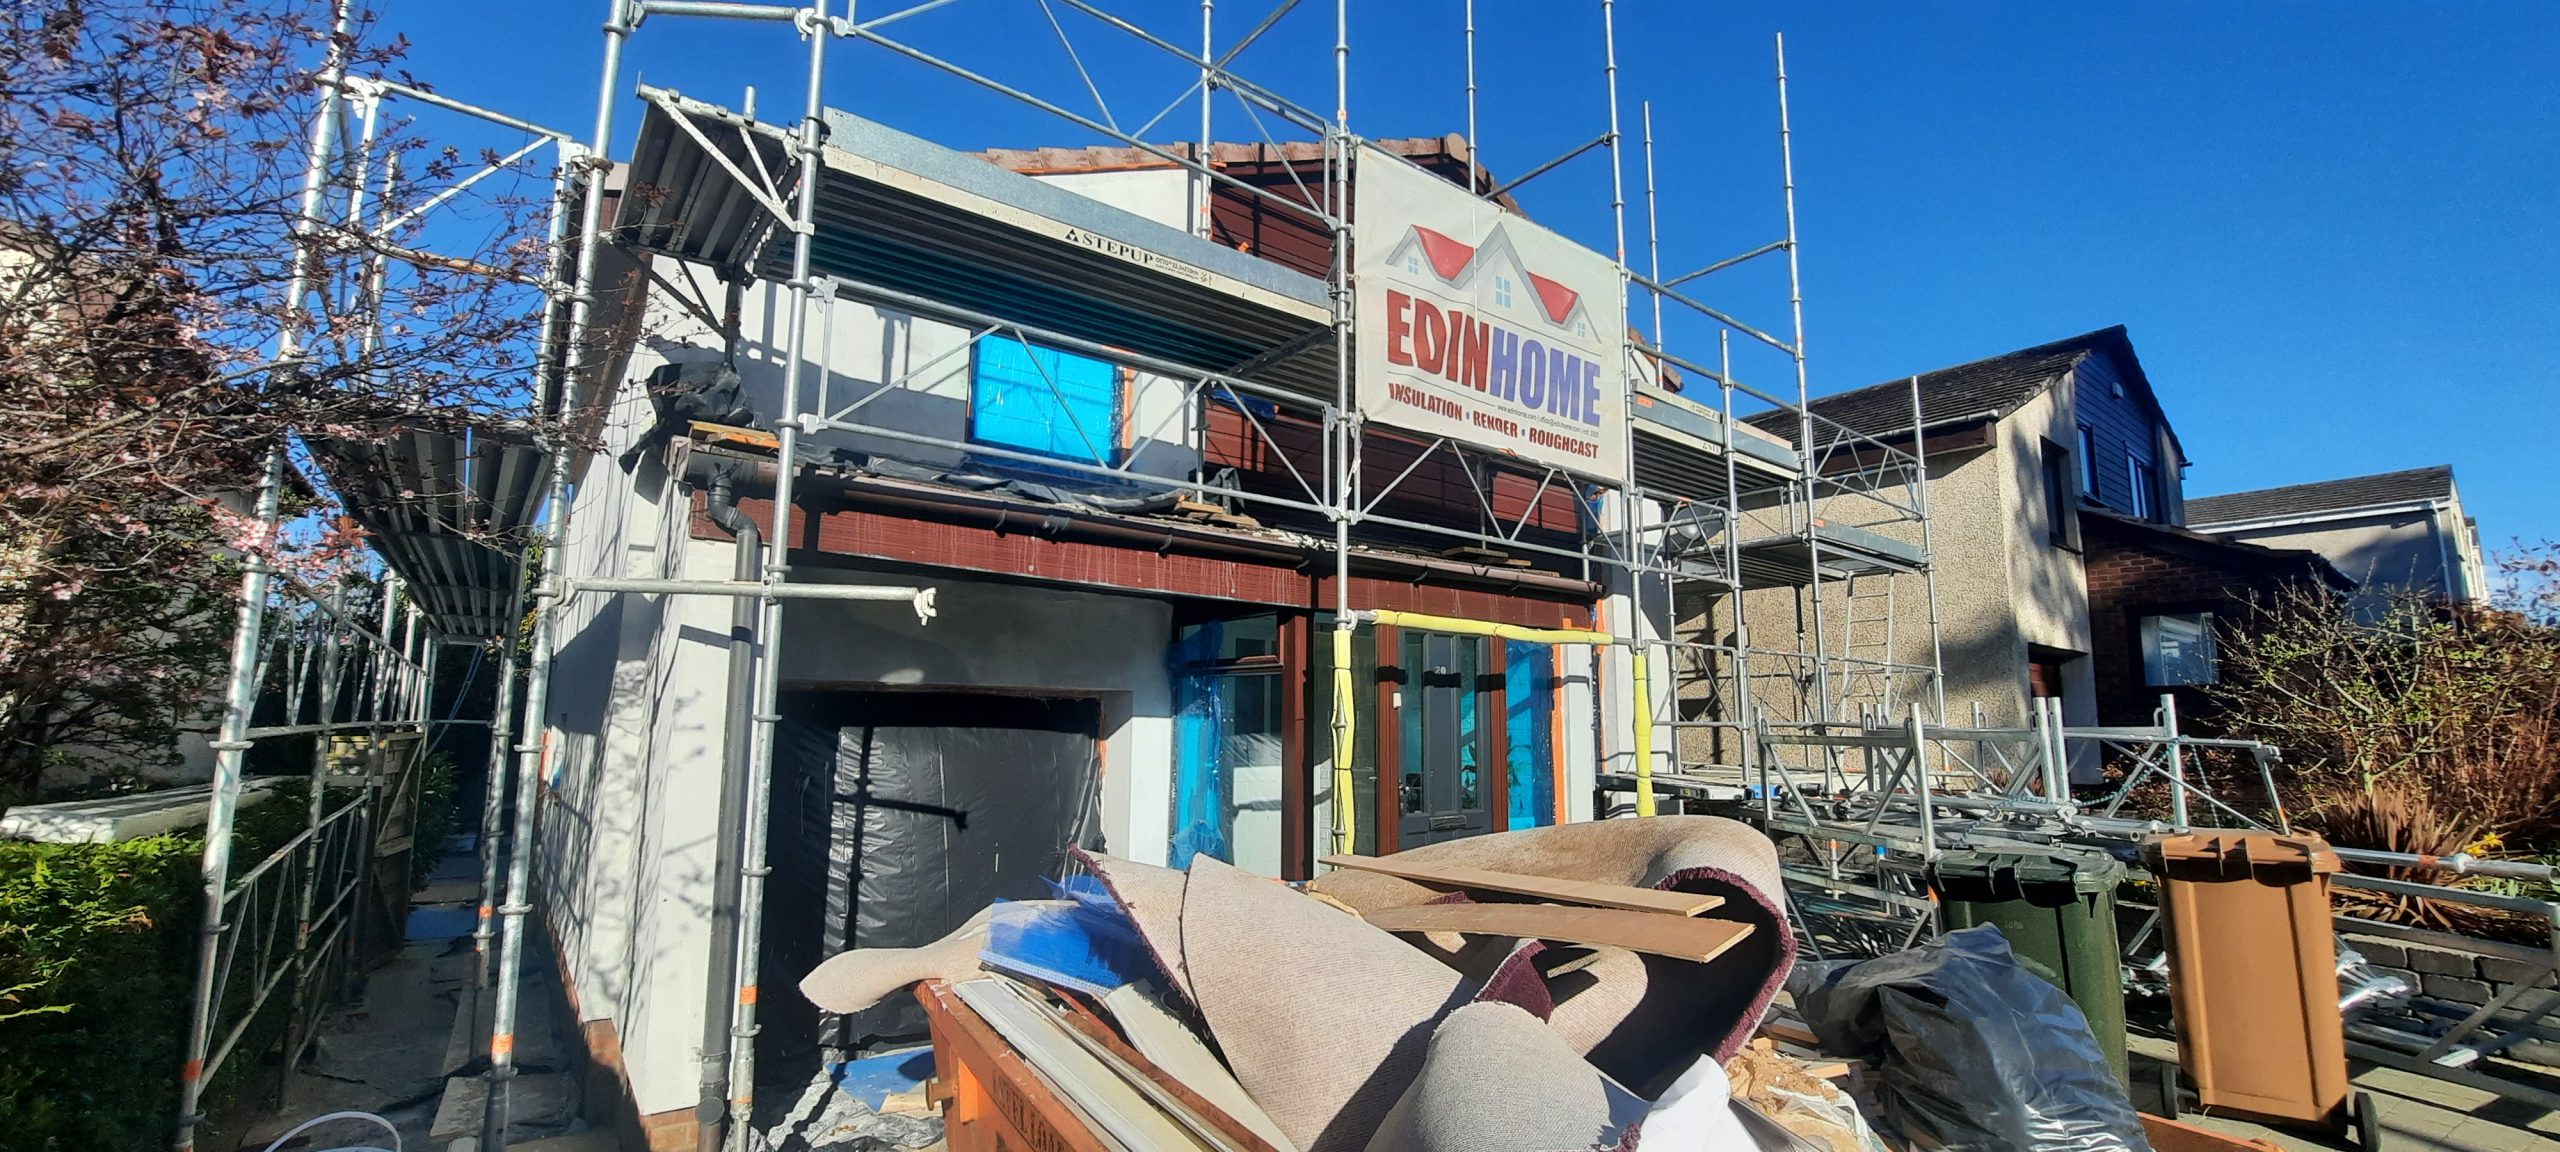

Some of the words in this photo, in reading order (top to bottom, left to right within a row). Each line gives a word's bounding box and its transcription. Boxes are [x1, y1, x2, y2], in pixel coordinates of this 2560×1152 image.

[1083, 233, 1153, 264] STEPUP
[1387, 288, 1601, 427] EDINHOME
[1388, 383, 1463, 422] INSULATION
[1473, 409, 1518, 439] RENDER
[1529, 427, 1600, 460] ROUGHCAST
